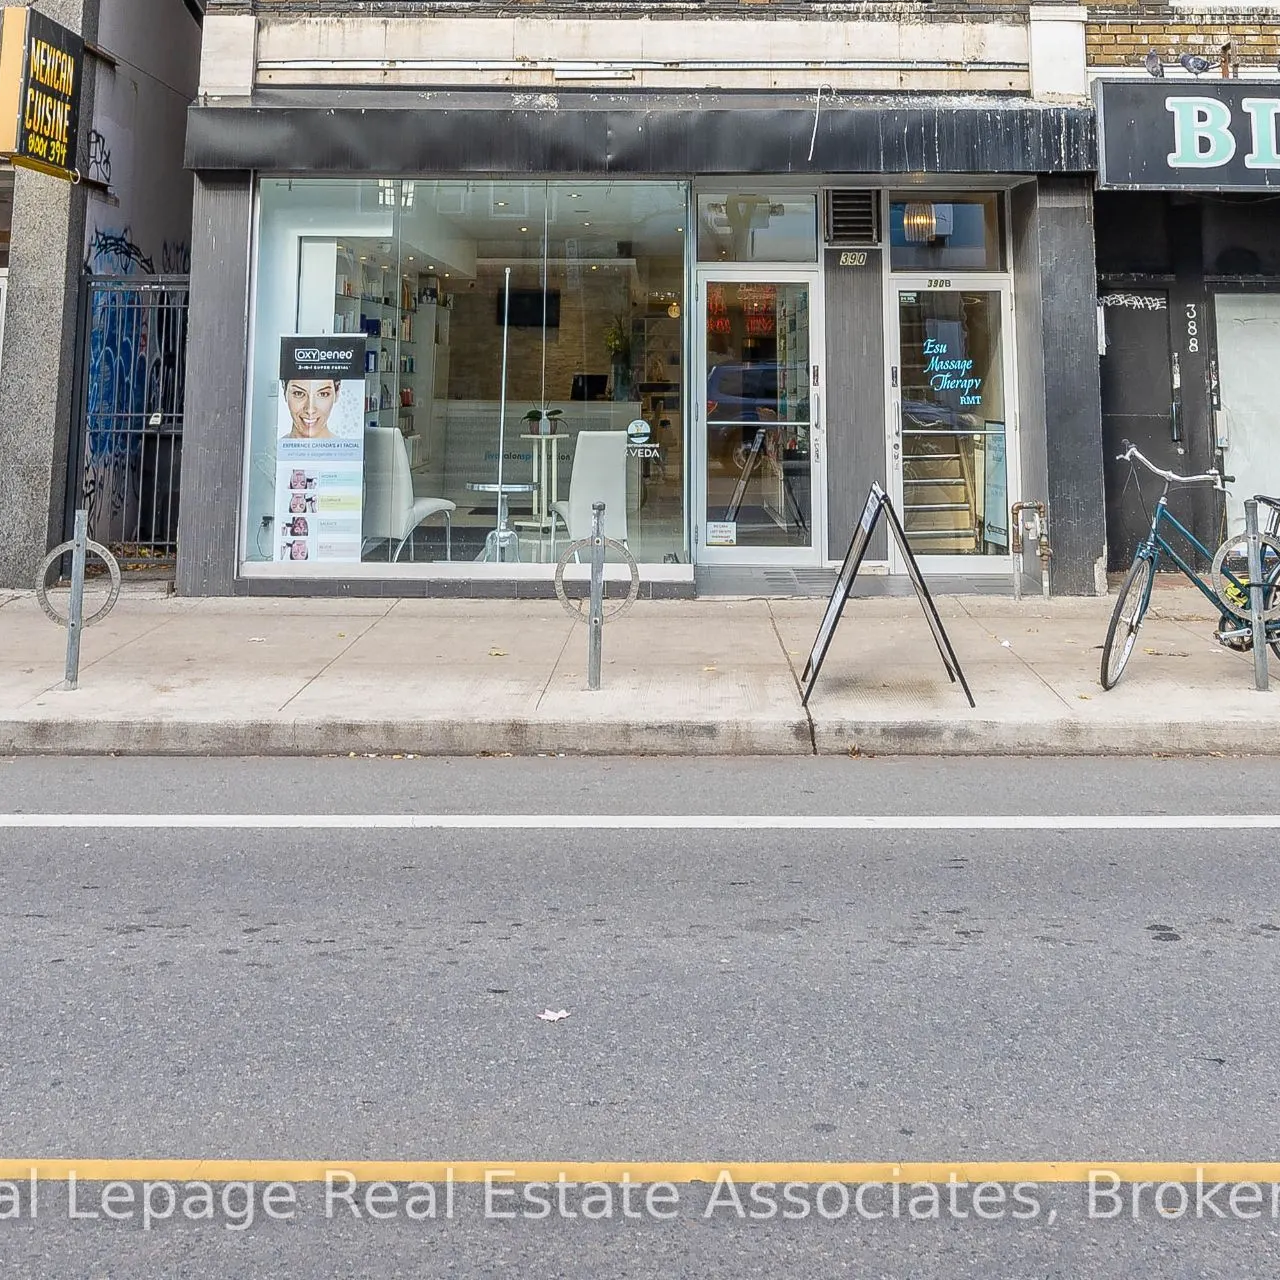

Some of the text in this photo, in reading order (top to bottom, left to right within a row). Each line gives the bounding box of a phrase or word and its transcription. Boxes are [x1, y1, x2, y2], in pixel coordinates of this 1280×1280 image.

[30, 37, 74, 96] MEXICAN
[24, 88, 70, 143] CUISINE
[48, 141, 66, 166] 394
[841, 252, 866, 265] 390
[928, 280, 952, 288] 390B
[1186, 304, 1198, 352] 388
[923, 338, 948, 354] Esu
[924, 356, 973, 376] Massage
[930, 374, 982, 396] Therapy
[960, 396, 982, 404] RMT
